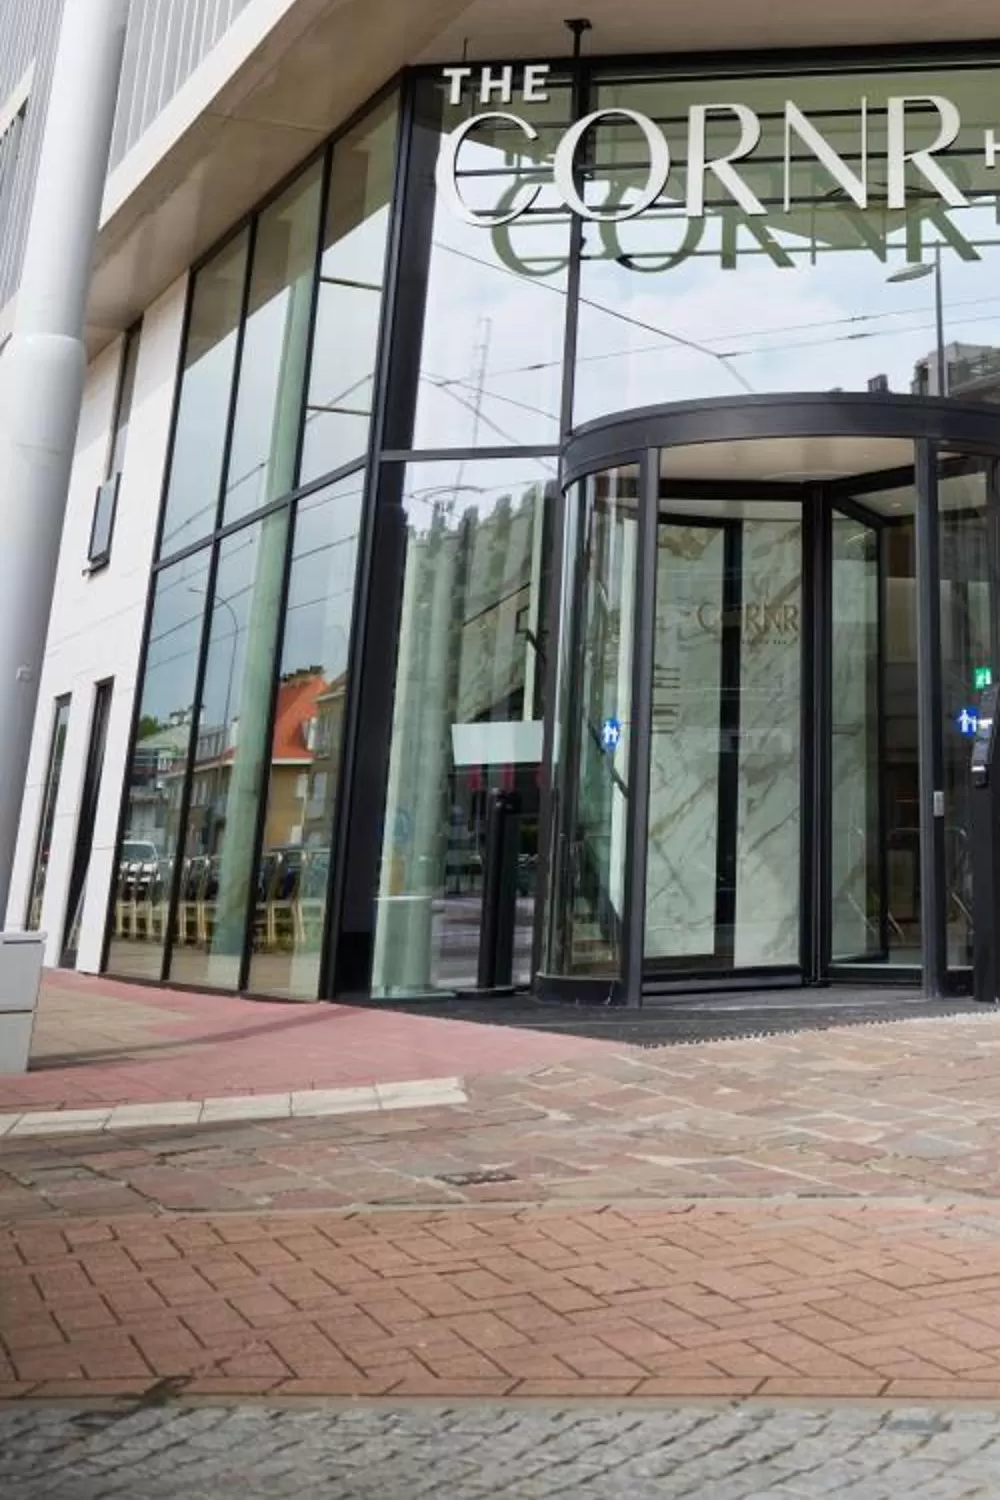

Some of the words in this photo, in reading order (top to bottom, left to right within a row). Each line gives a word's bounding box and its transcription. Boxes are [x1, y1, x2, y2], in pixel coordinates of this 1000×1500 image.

[443, 64, 550, 105] THE
[435, 95, 971, 228] CORNR
[697, 602, 799, 633] CRNR
